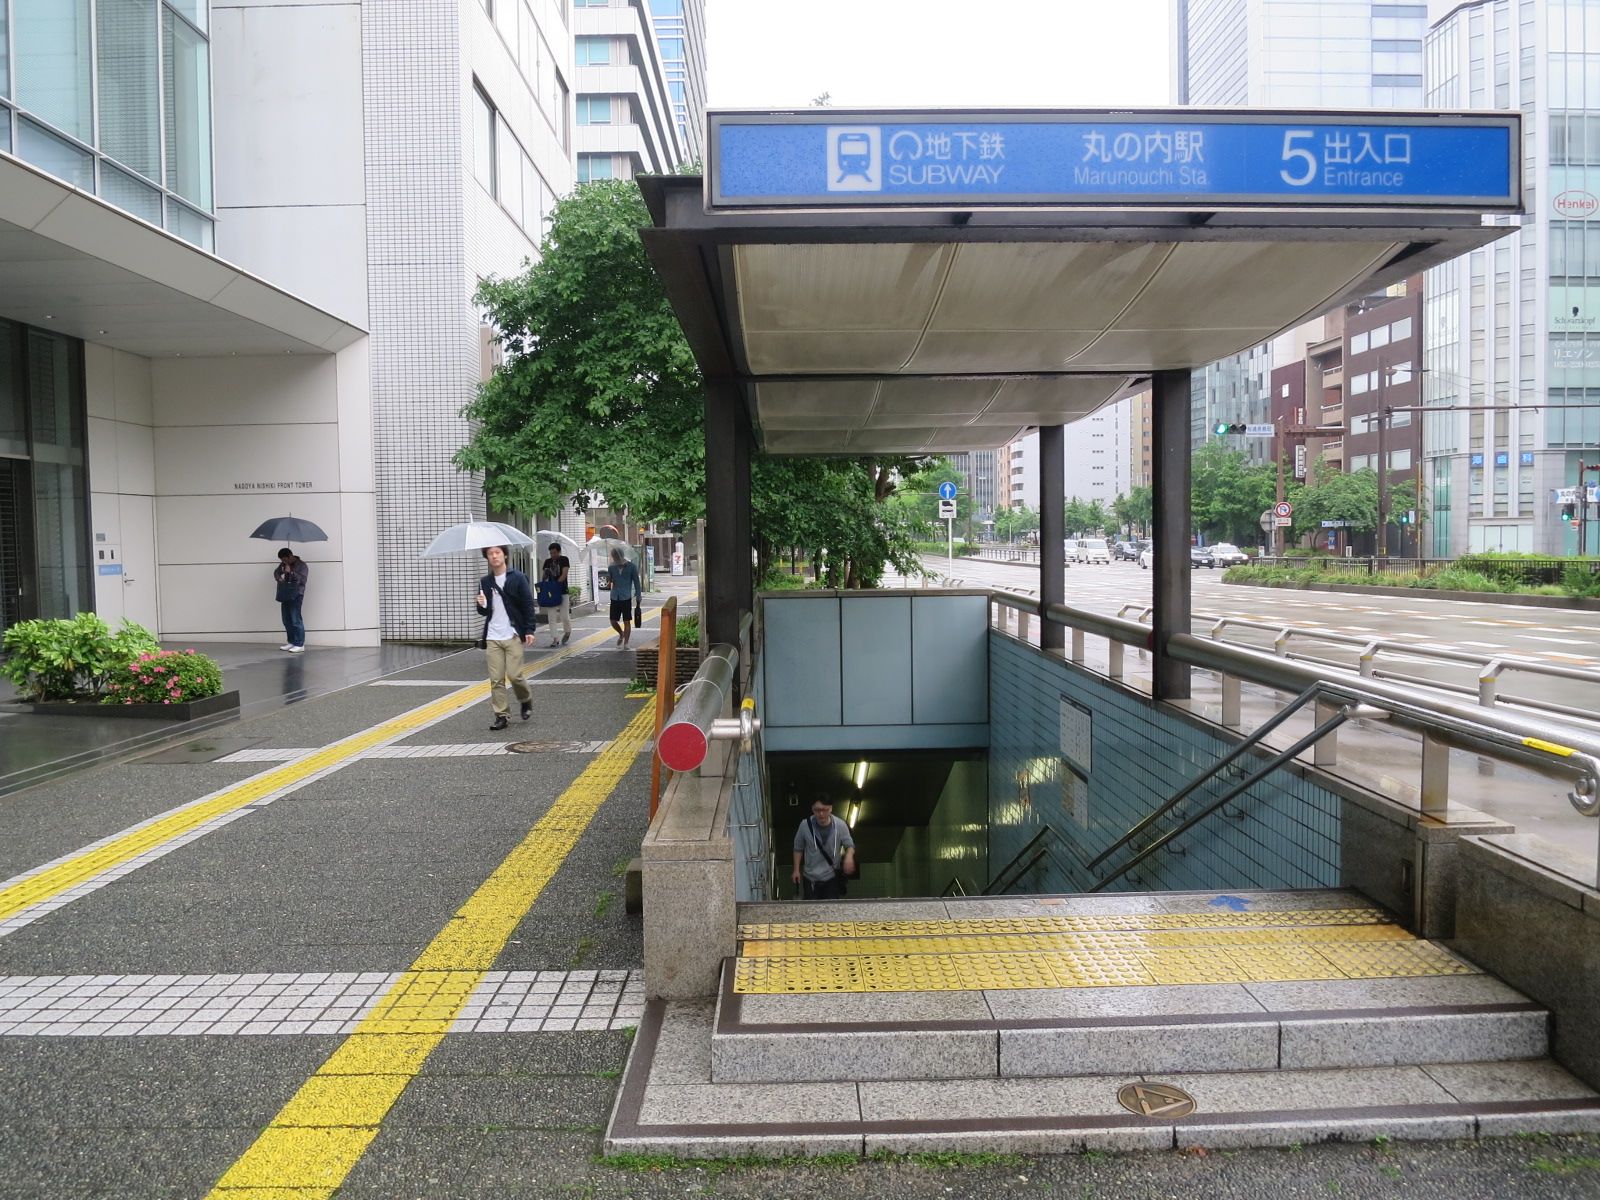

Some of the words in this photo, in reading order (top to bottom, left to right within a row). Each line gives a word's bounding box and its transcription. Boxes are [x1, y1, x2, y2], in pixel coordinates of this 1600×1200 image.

[925, 131, 1006, 162] 地下鉄
[1081, 131, 1205, 164] 丸の内駅
[1323, 132, 1412, 165] 出入口
[1279, 129, 1318, 187] 5
[889, 164, 1005, 186] SUBWAY
[1073, 166, 1175, 186] Marunouchi
[1323, 166, 1405, 187] Entrance
[1557, 199, 1595, 209] Henkel
[234, 482, 255, 490] NAGOYA
[277, 481, 294, 489] FRONT
[295, 481, 313, 489] TOWER
